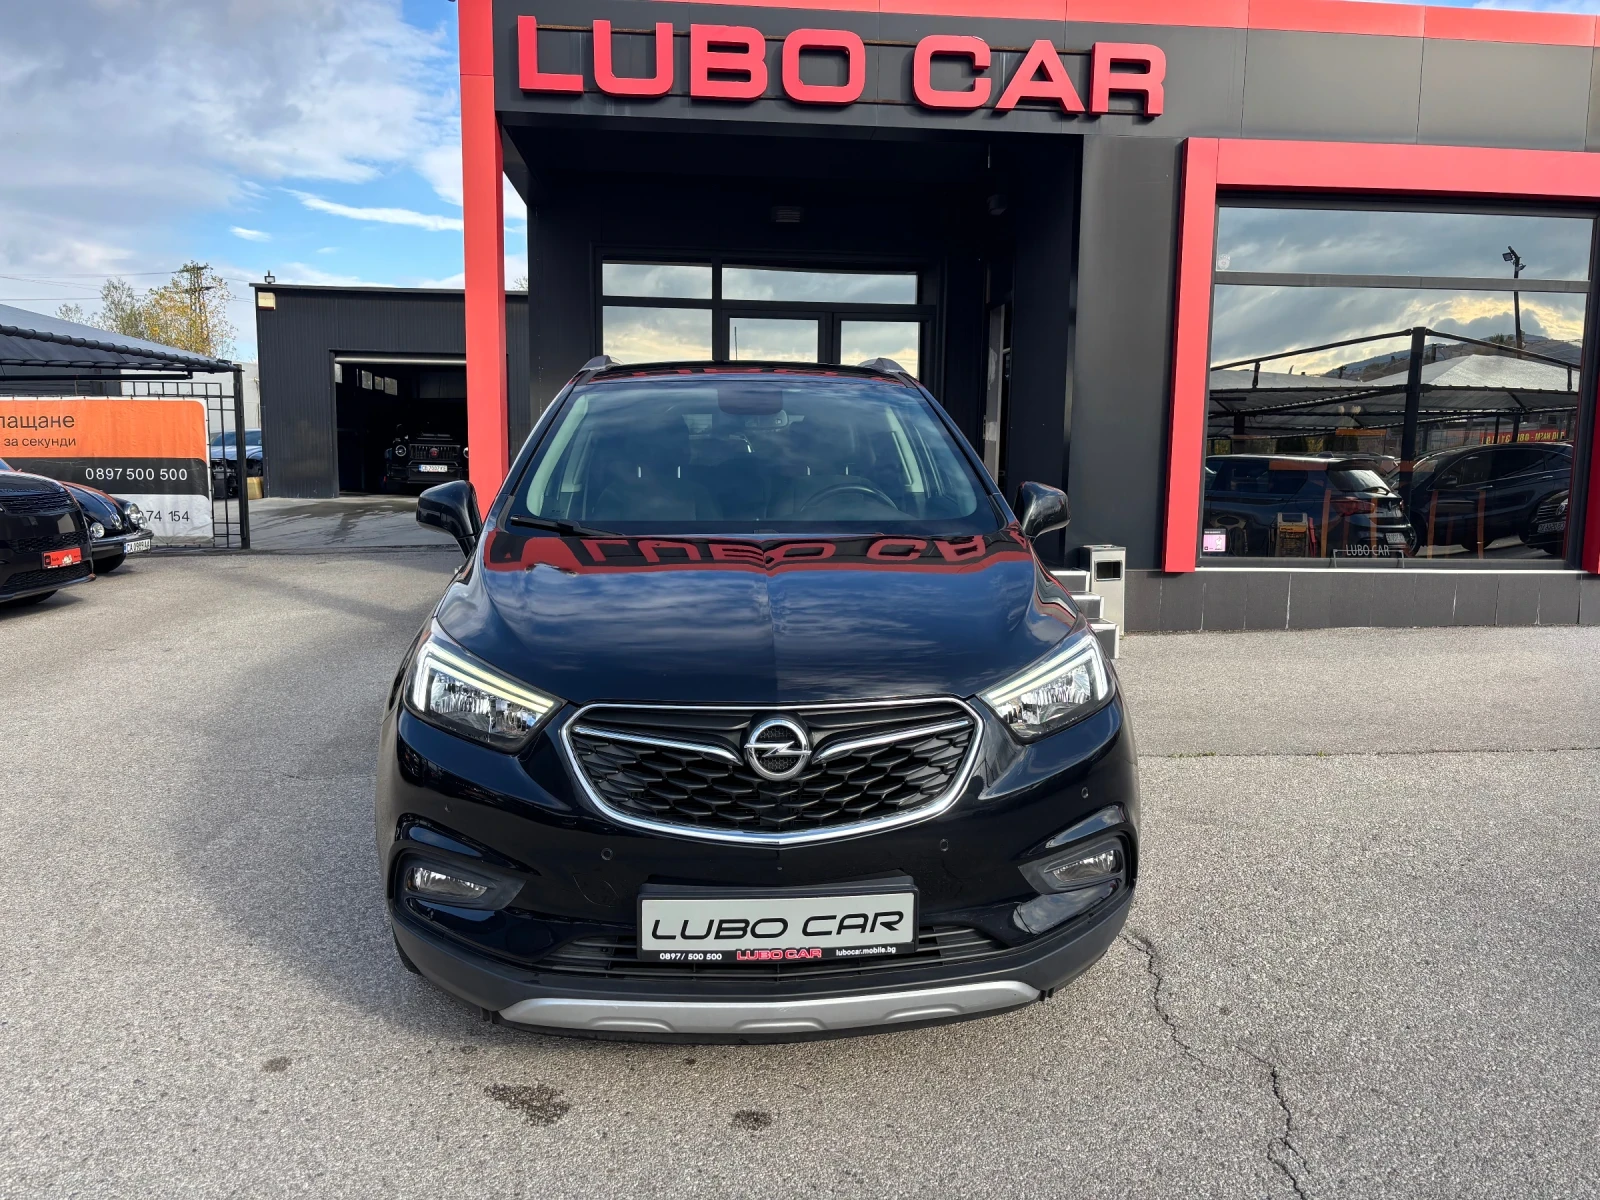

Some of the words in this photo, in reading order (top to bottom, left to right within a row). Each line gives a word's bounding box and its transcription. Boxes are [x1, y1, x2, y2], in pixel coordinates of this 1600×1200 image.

[517, 15, 866, 104] LUBO
[913, 35, 1167, 117] CAR
[4, 438, 19, 447] за
[22, 438, 77, 449] секунди
[85, 467, 123, 480] 0897
[126, 468, 155, 480] 500
[160, 468, 188, 481] 500
[168, 510, 190, 522] 154
[1345, 544, 1370, 556] LUBO
[1372, 544, 1390, 556] CAR
[651, 917, 789, 940] LUBO
[801, 910, 905, 937] CAR
[659, 952, 686, 960] 0897/
[736, 950, 783, 961] LUBO
[785, 948, 822, 959] CAR
[835, 945, 897, 957] lubocar.mobile.bg
